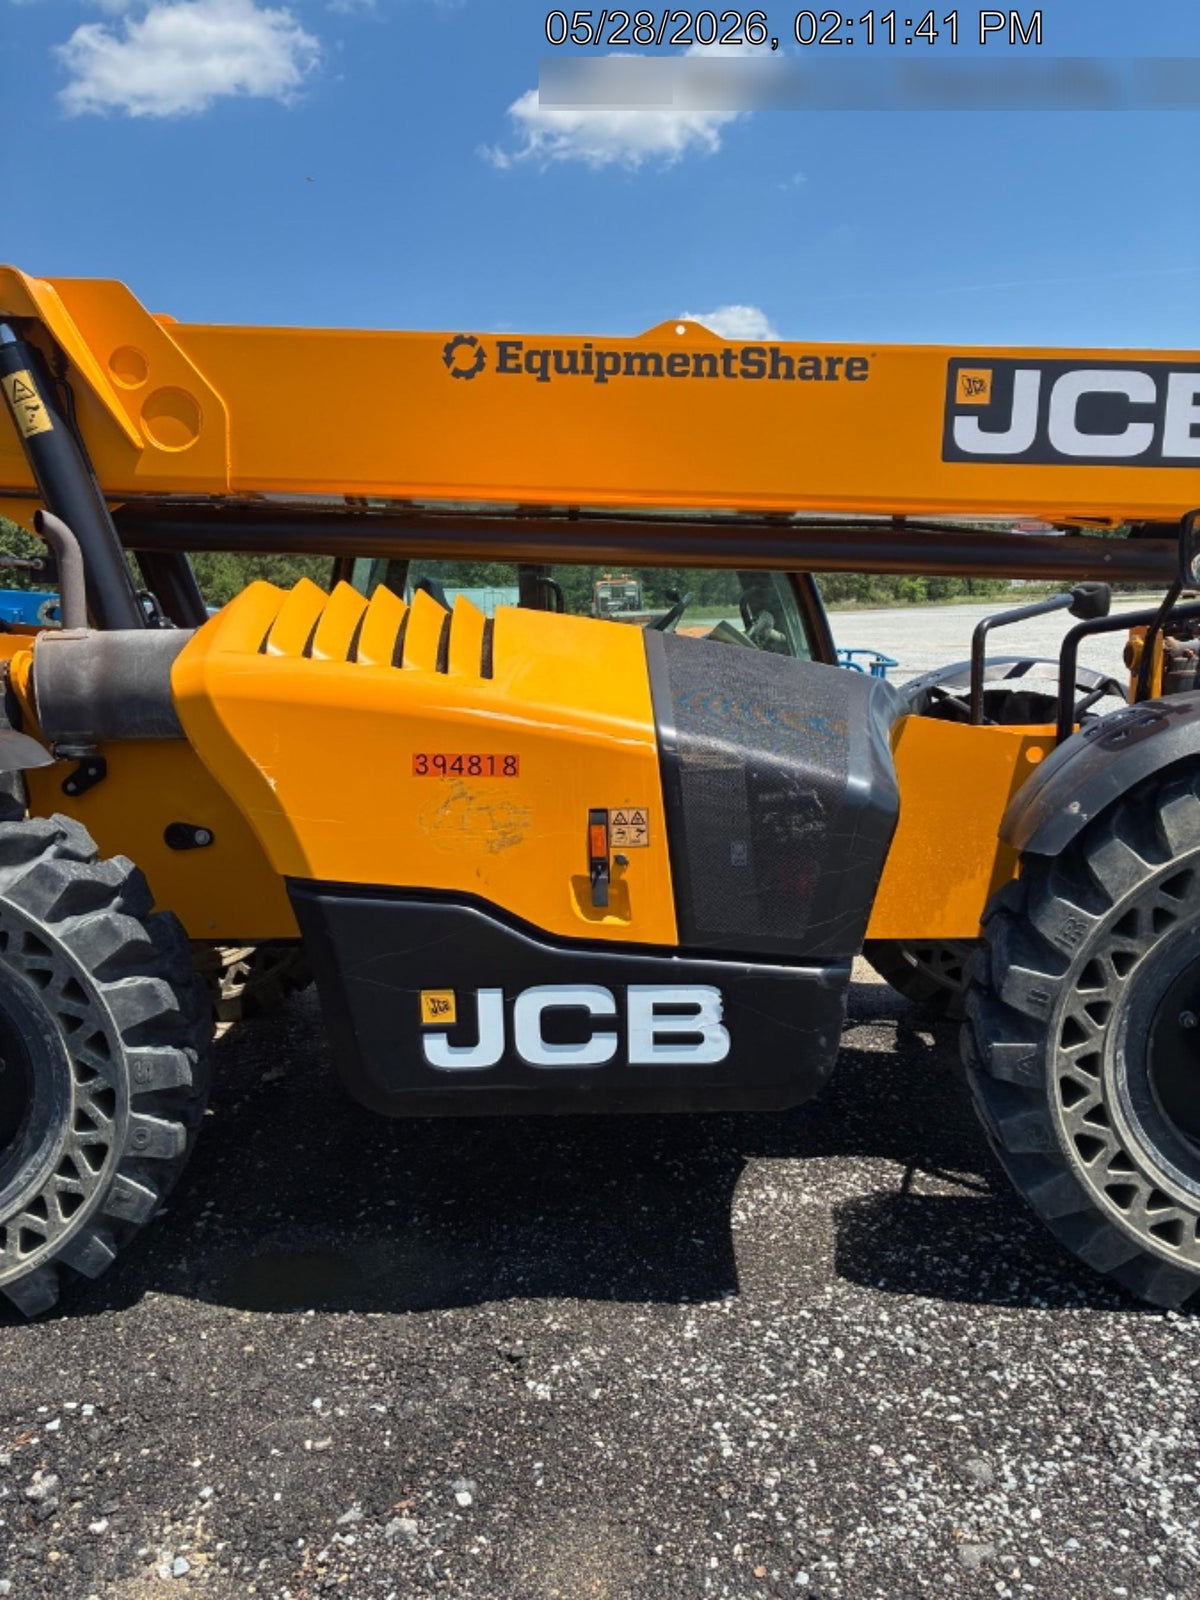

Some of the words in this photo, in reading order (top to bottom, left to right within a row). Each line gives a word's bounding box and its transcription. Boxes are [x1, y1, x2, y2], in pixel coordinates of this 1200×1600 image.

[496, 341, 869, 384] EquipmentShare
[415, 754, 517, 776] 394818
[423, 984, 730, 1068] JCB
